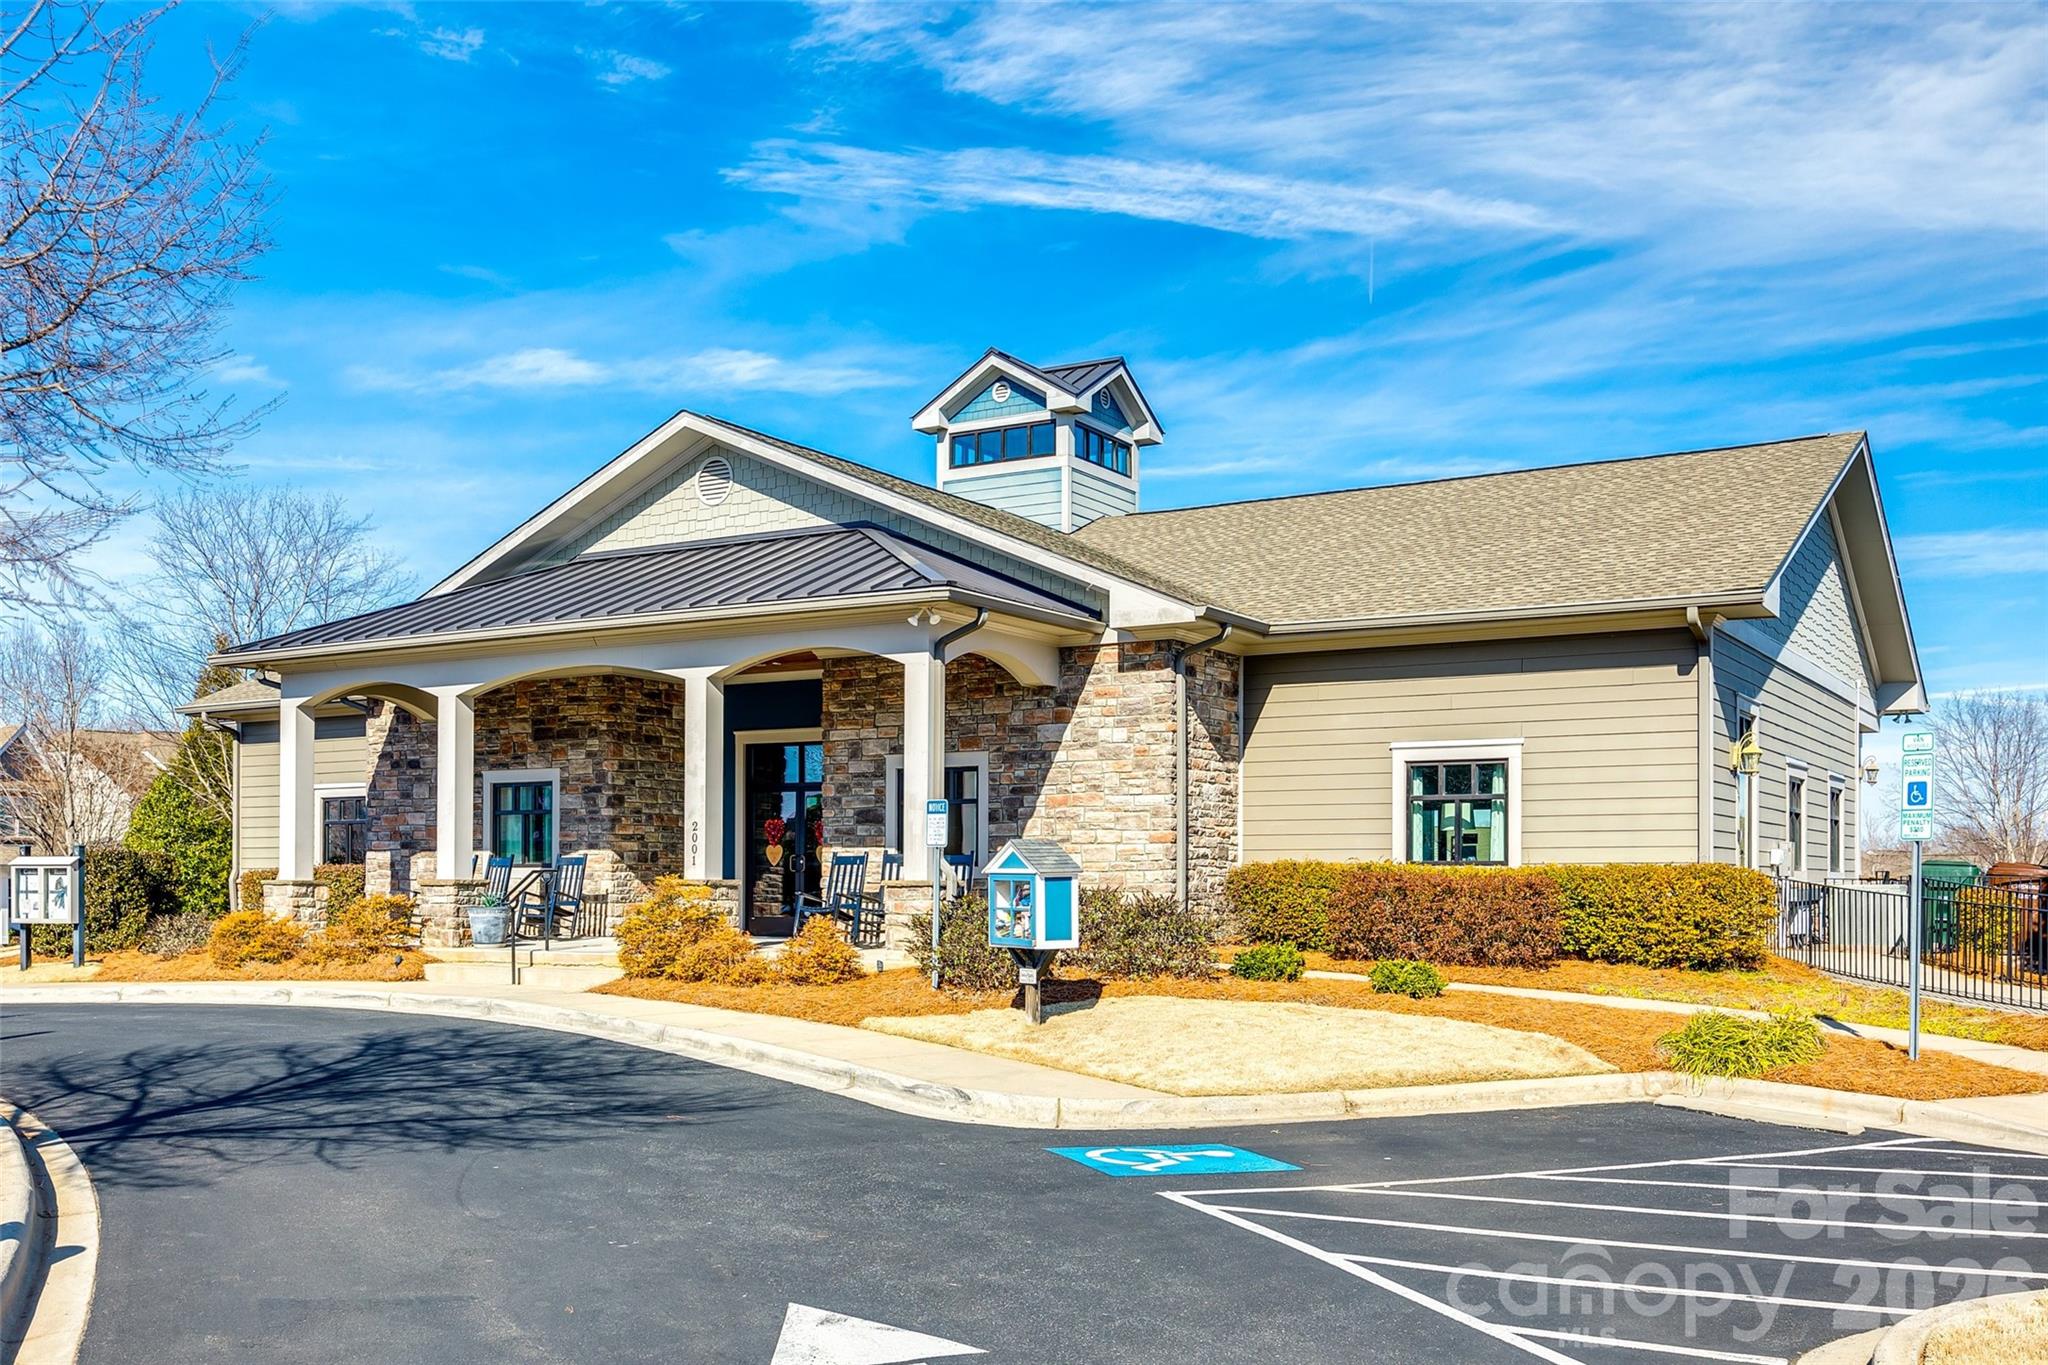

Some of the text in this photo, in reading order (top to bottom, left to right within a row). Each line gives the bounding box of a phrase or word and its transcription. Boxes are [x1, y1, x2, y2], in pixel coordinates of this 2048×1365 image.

[1904, 758, 1932, 767] RESERVED
[1905, 768, 1931, 777] PARKING
[928, 802, 946, 812] NOTICE
